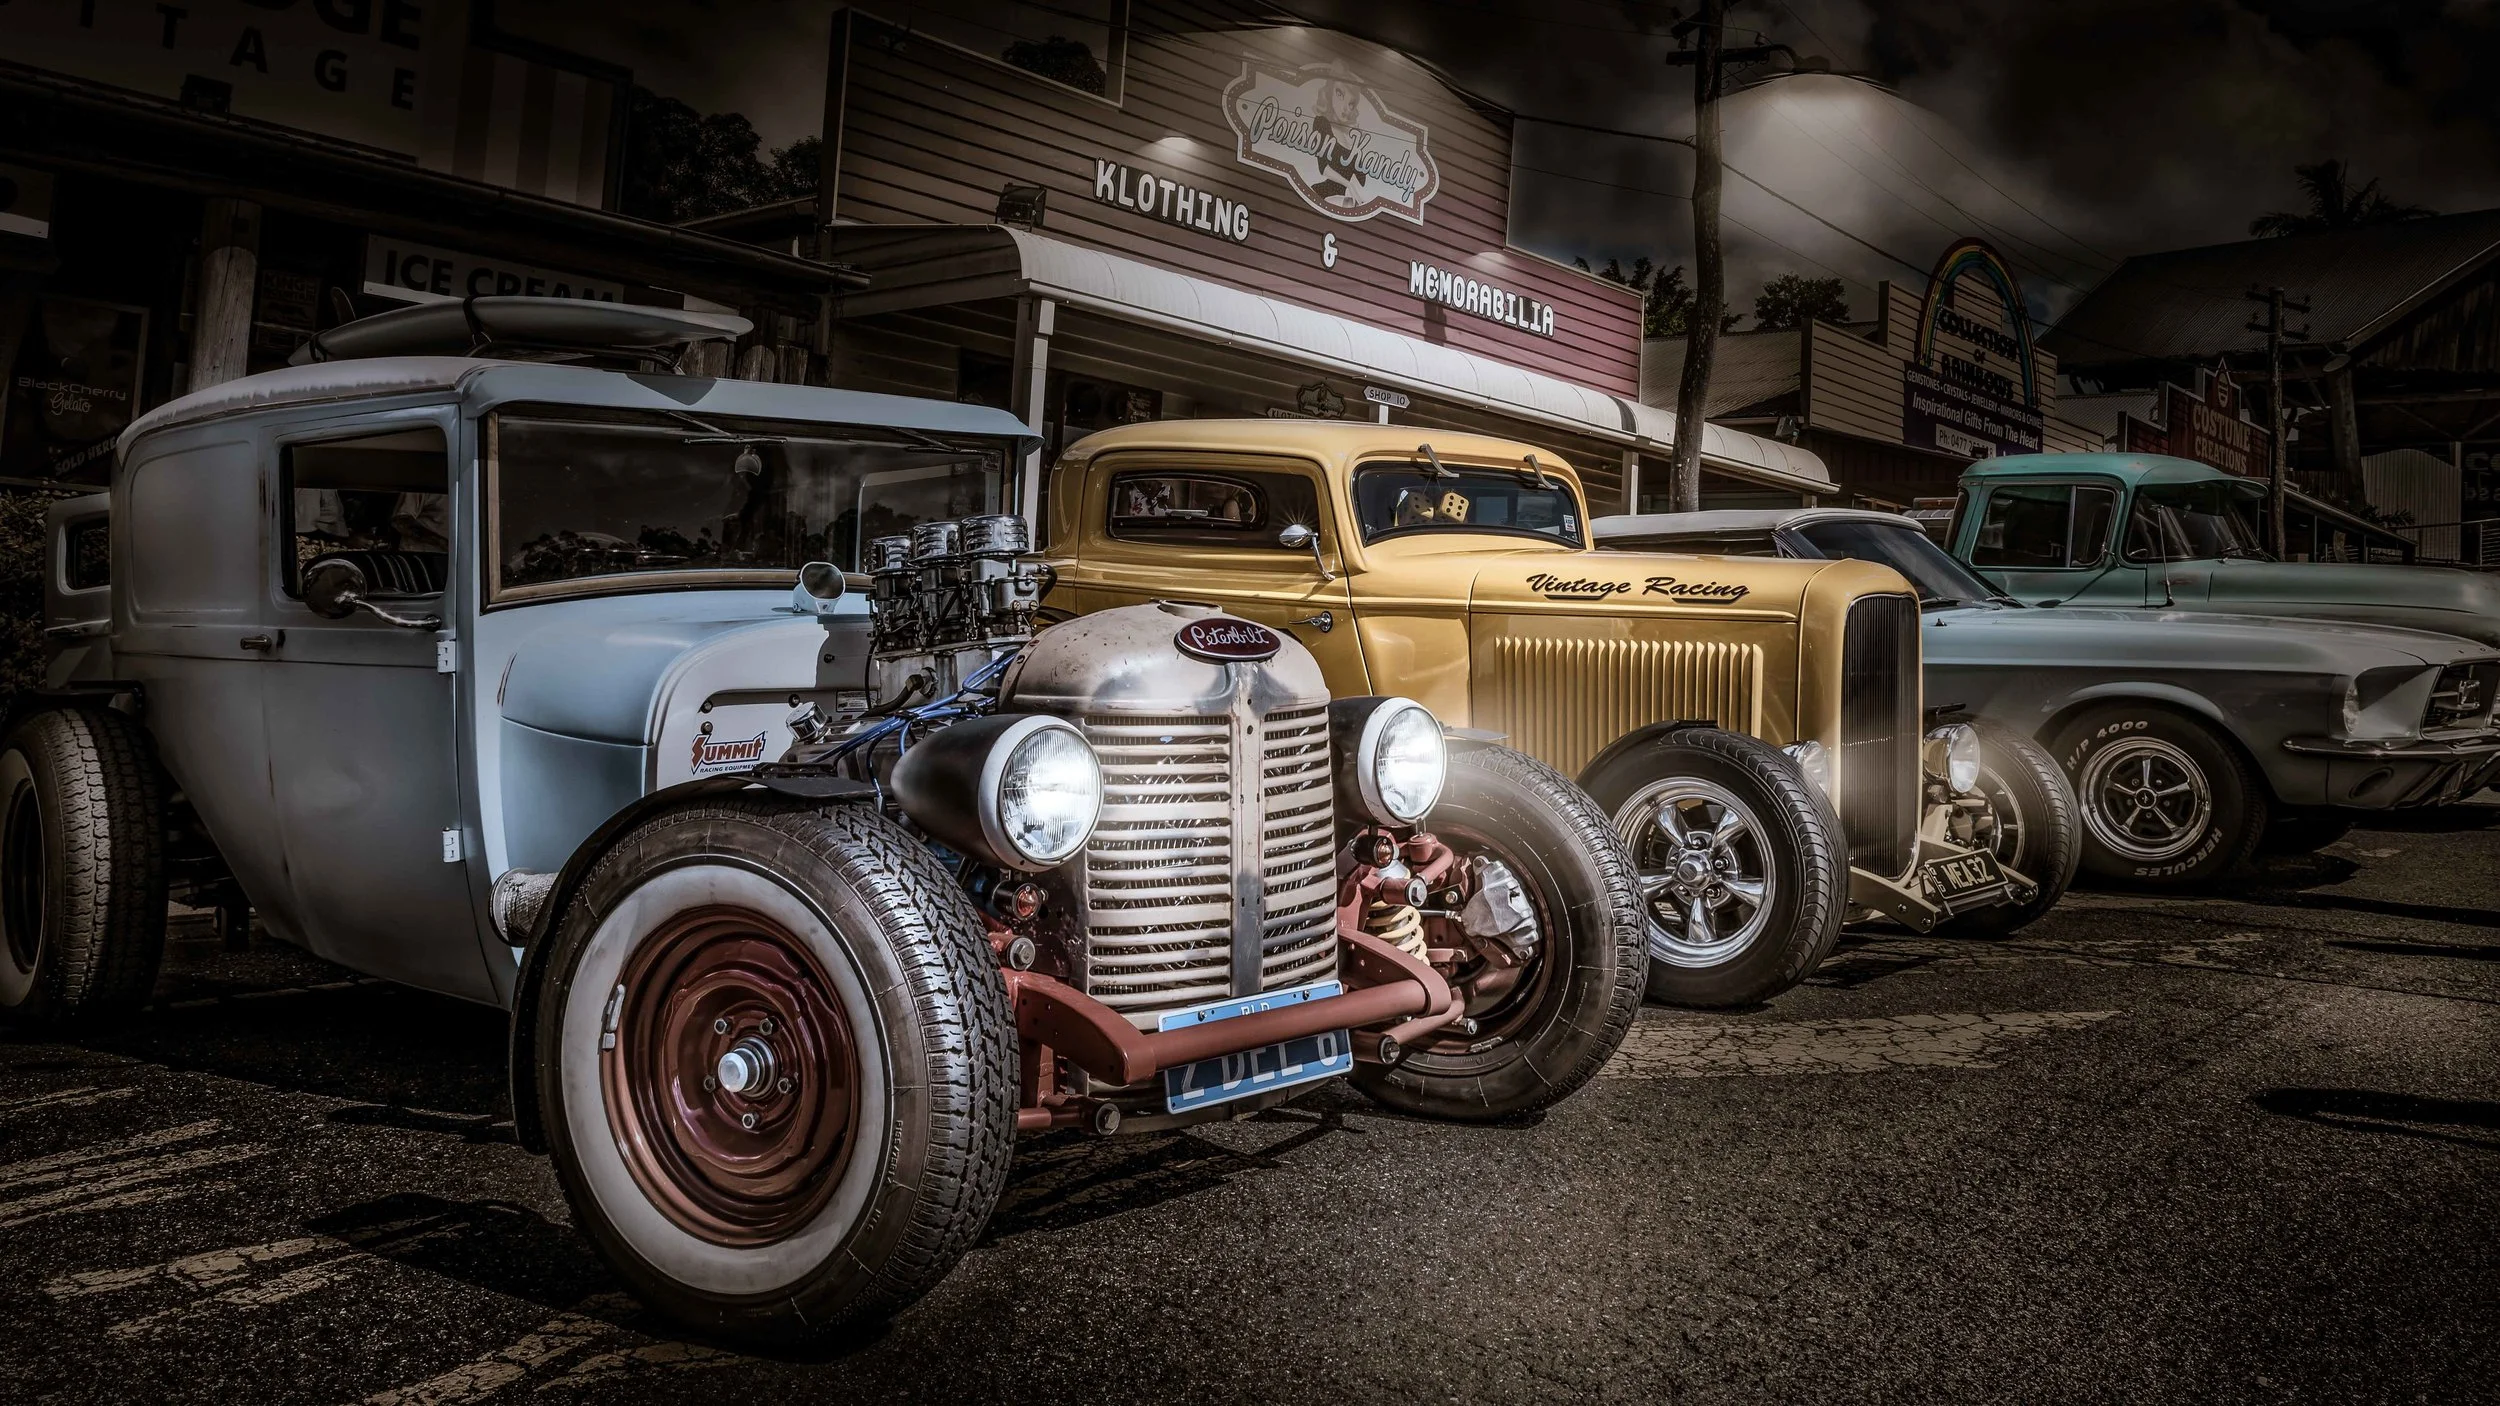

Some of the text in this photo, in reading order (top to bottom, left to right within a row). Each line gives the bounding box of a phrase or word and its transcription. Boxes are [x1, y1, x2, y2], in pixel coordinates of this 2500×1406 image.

[1249, 96, 1419, 203] Poison Kandy
[1094, 158, 1250, 242] KLOTHING
[1322, 231, 1338, 269] &
[385, 250, 455, 297] ICE
[1409, 258, 1555, 337] MEMORABILIA
[17, 376, 127, 401] BlackCherry
[49, 391, 94, 416] Gelato
[1368, 389, 1392, 402] SHOP
[1906, 369, 1941, 392] GEMSTONES
[1943, 383, 1969, 402] CRYSTALS
[1912, 391, 1964, 424] Inspirational
[1964, 408, 1983, 431] Gifts
[1983, 416, 2004, 439] From
[2004, 423, 2019, 444] The
[2019, 429, 2039, 452] Heart
[1938, 429, 1950, 445] Ph:
[2192, 403, 2251, 453] COSTUME
[54, 451, 86, 477] SOLD
[2194, 435, 2248, 475] CREATIONS
[1525, 573, 1750, 605] Vintage Racing
[1189, 625, 1270, 649] Peterbilt
[2066, 720, 2149, 771] H/P 4000
[699, 763, 758, 774] RACING EQUIPMEN
[2133, 827, 2224, 877] HERCULES
[1940, 856, 1996, 890] MEA32
